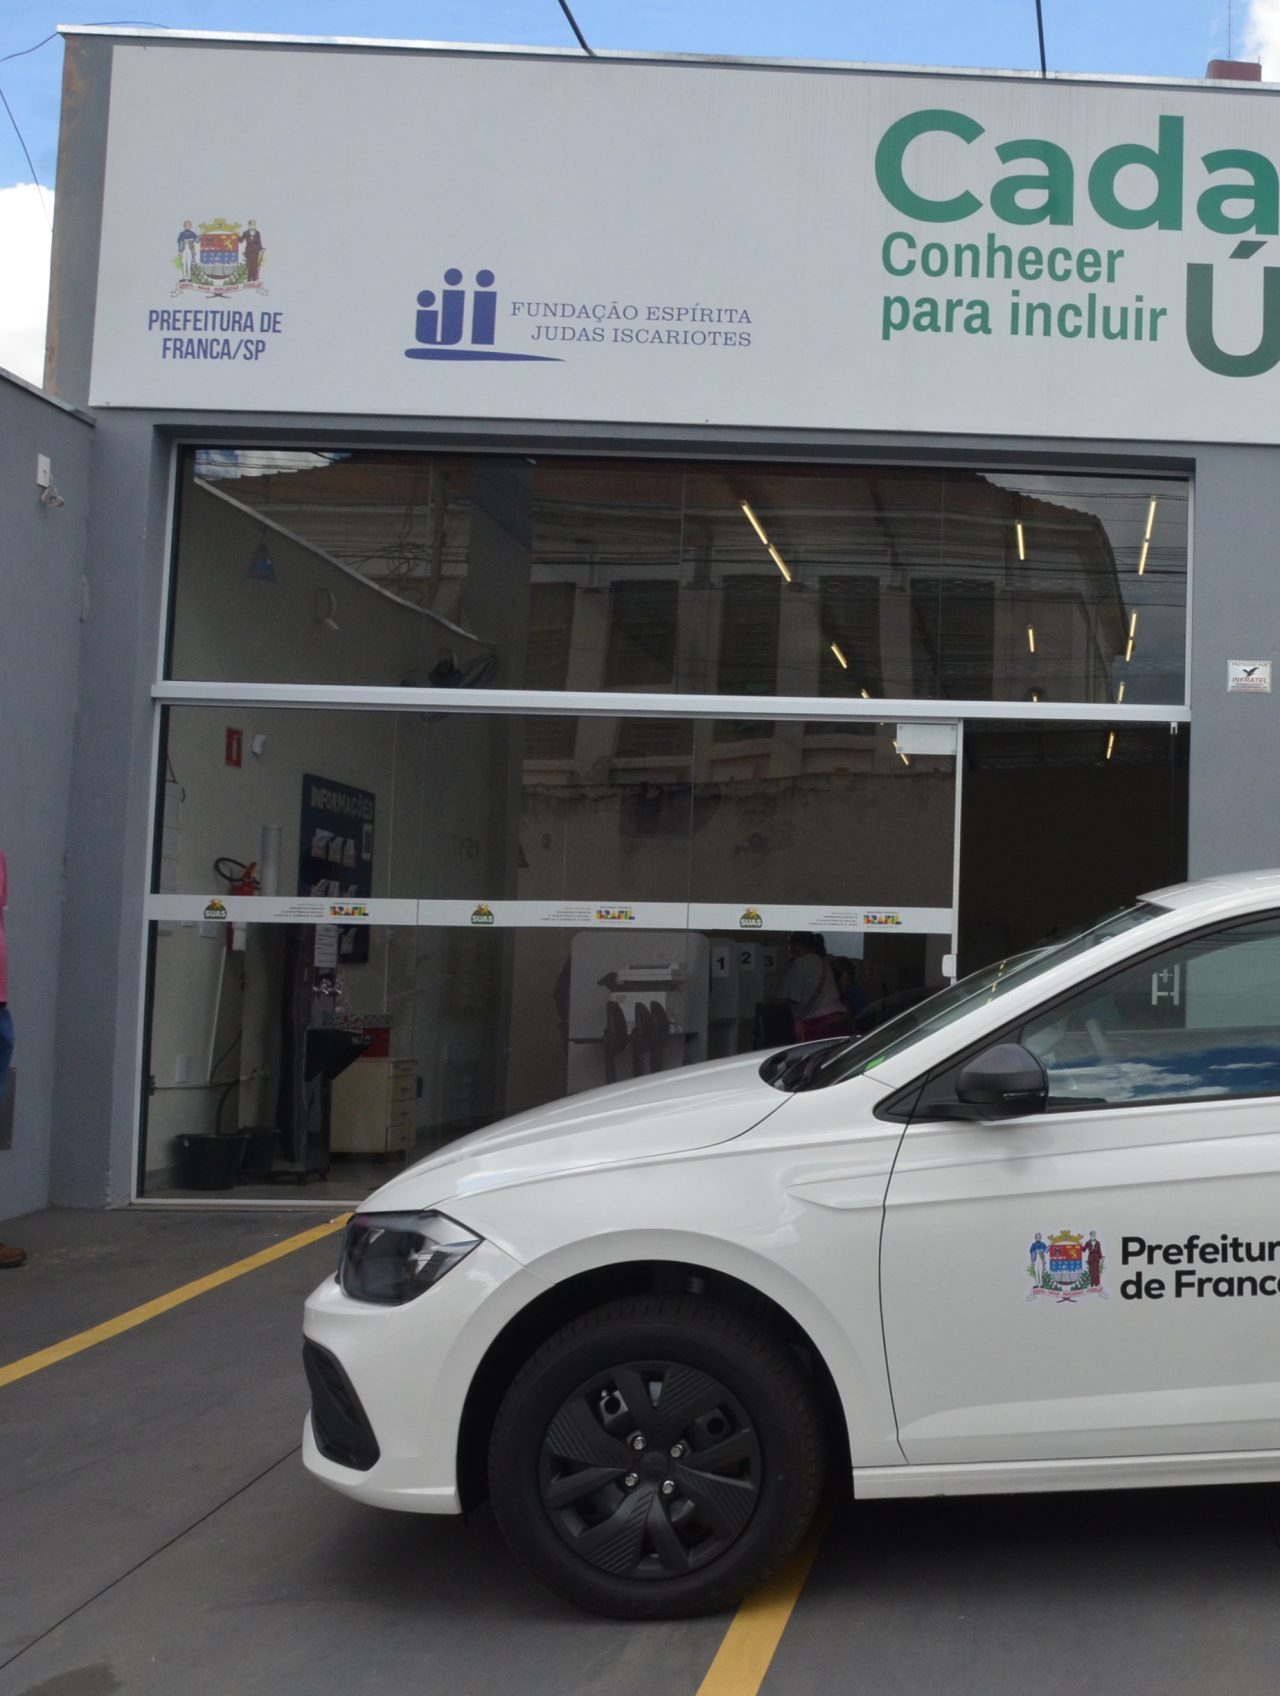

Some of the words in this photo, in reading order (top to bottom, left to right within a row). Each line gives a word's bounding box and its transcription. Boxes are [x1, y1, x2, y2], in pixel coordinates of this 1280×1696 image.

[881, 231, 1124, 283] Conhecer
[148, 309, 255, 333] PREFEITURA
[259, 311, 284, 333] DE
[511, 301, 638, 323] FUNDAÇÃO
[646, 302, 752, 324] ESPÍRITA
[882, 295, 992, 341] para
[1010, 289, 1167, 341] incluir
[531, 325, 605, 343] JUDAS
[612, 327, 752, 347] ISCARIOTES
[162, 337, 266, 361] FRANCA/SP
[716, 956, 725, 970] 1
[741, 951, 751, 965] 2
[764, 955, 774, 968] 3
[1120, 1271, 1165, 1300] de
